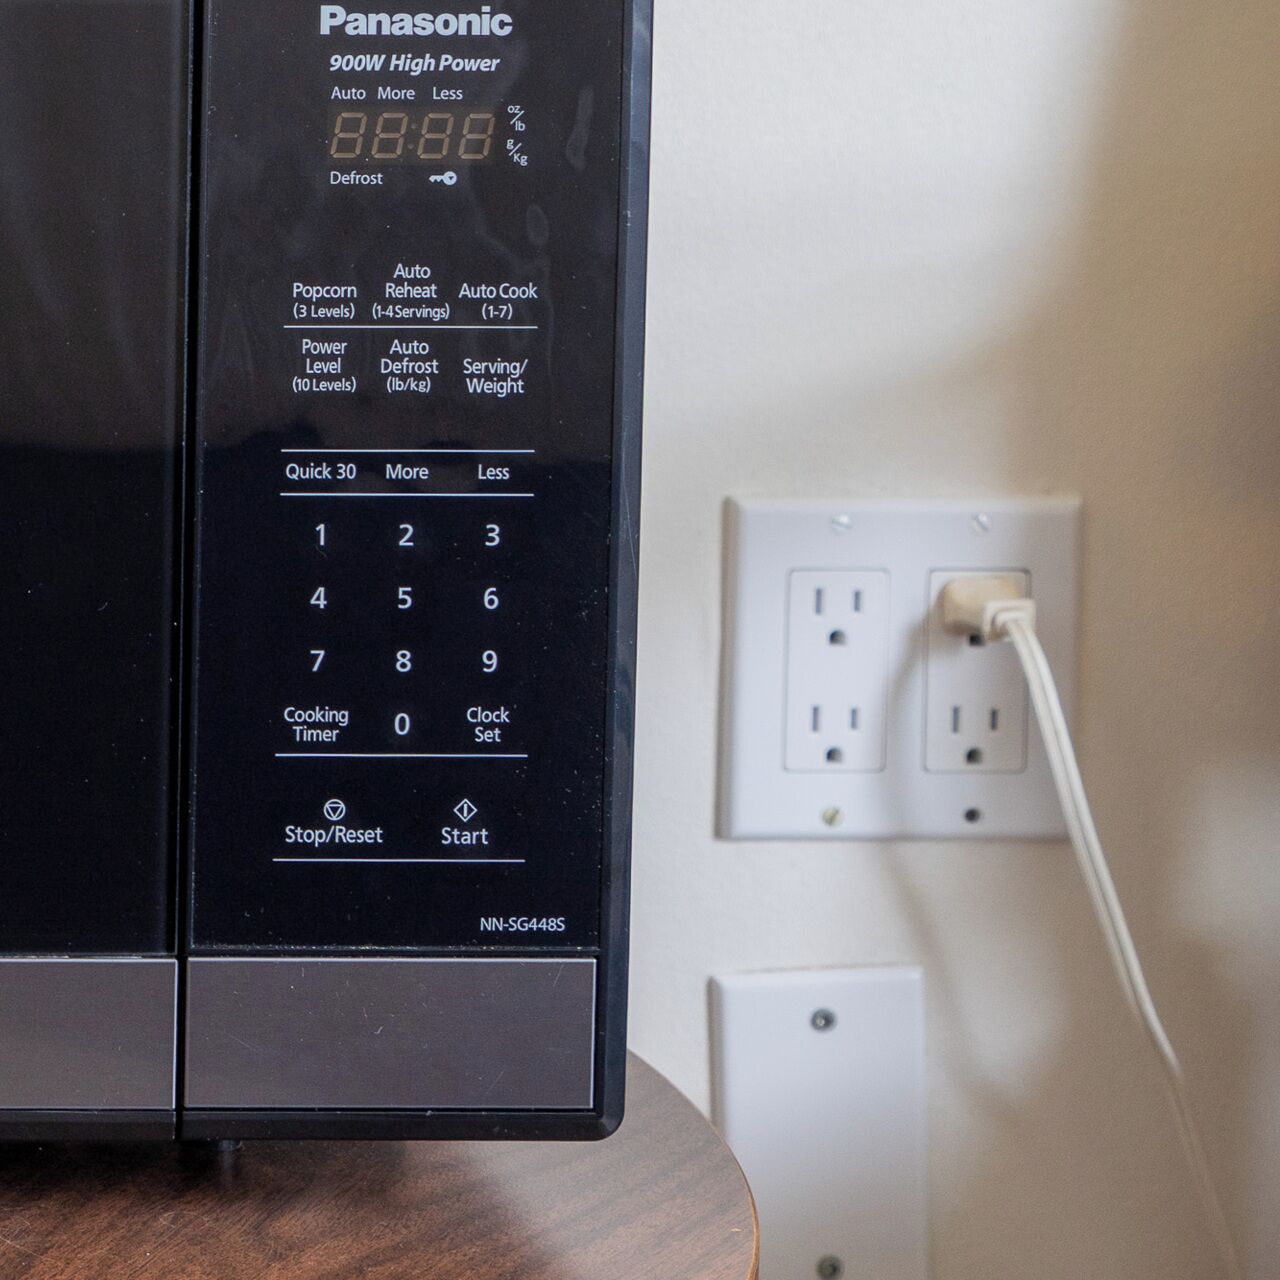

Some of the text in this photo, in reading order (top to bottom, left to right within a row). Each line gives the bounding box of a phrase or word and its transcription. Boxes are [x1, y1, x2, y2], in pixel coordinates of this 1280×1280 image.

[320, 5, 513, 36] Panasonic
[329, 53, 501, 76] 900W High Power
[330, 86, 367, 100] Auto
[377, 86, 416, 100] More
[432, 86, 464, 100] Less
[330, 170, 384, 185] Defrost
[393, 263, 431, 279] Auto
[292, 282, 357, 302] Popcorn
[385, 282, 437, 298] Reheat
[458, 282, 538, 299] Auto Cook
[293, 302, 355, 320] (3 Levels)
[394, 302, 450, 321] Servings)
[481, 302, 513, 320] (1-7)
[302, 338, 348, 355] Power
[389, 339, 430, 355] Auto
[306, 357, 341, 374] Level
[380, 357, 439, 374] Defrost
[463, 357, 529, 379] Serving/
[292, 376, 357, 393] (10 Levels)
[386, 376, 431, 393] (lb/kg)
[465, 377, 525, 397] Weight
[285, 463, 357, 481] Quick 30
[386, 463, 429, 480] More
[478, 463, 510, 480] Less
[315, 523, 325, 546] 1
[398, 523, 414, 547] 2
[485, 523, 500, 547] 3
[309, 586, 328, 609] 4
[397, 586, 412, 609] 5
[483, 587, 499, 610] 6
[310, 649, 326, 672] 7
[395, 649, 412, 673] 8
[482, 650, 498, 673] 9
[283, 705, 349, 727] Cooking
[466, 706, 510, 723] Clock
[394, 712, 410, 736] 0
[292, 725, 340, 742] Timer
[474, 726, 501, 743] Set
[285, 825, 383, 847] Stop/Reset
[441, 826, 489, 845] Start
[480, 917, 565, 932] NN-SG448S
